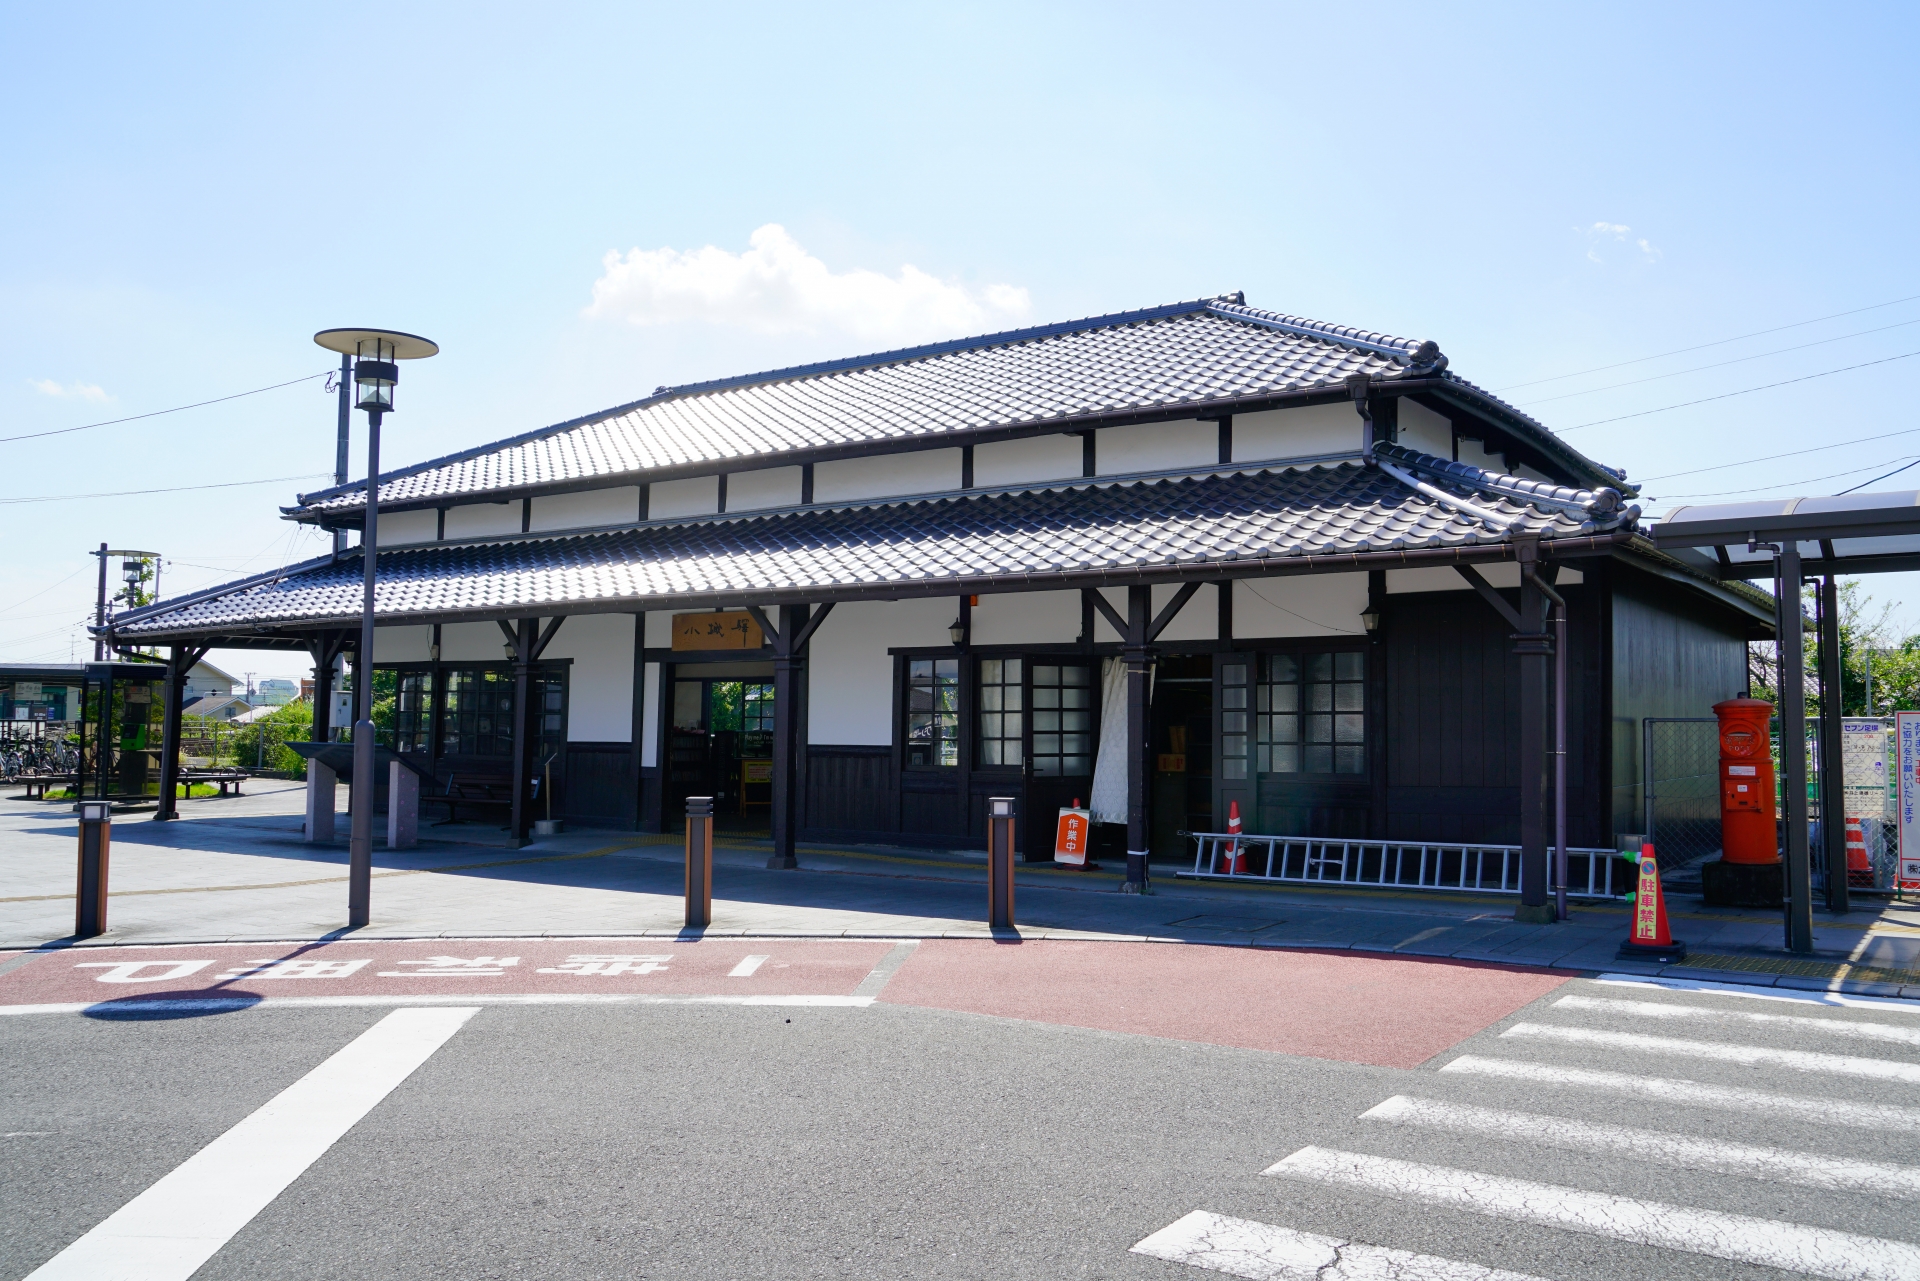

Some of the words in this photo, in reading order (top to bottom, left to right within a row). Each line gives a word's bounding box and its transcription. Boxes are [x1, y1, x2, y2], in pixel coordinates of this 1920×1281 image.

[1902, 722, 1914, 824] ご協力をお願いいたします
[1065, 818, 1079, 852] 作業中
[1639, 878, 1656, 939] 駐車禁止
